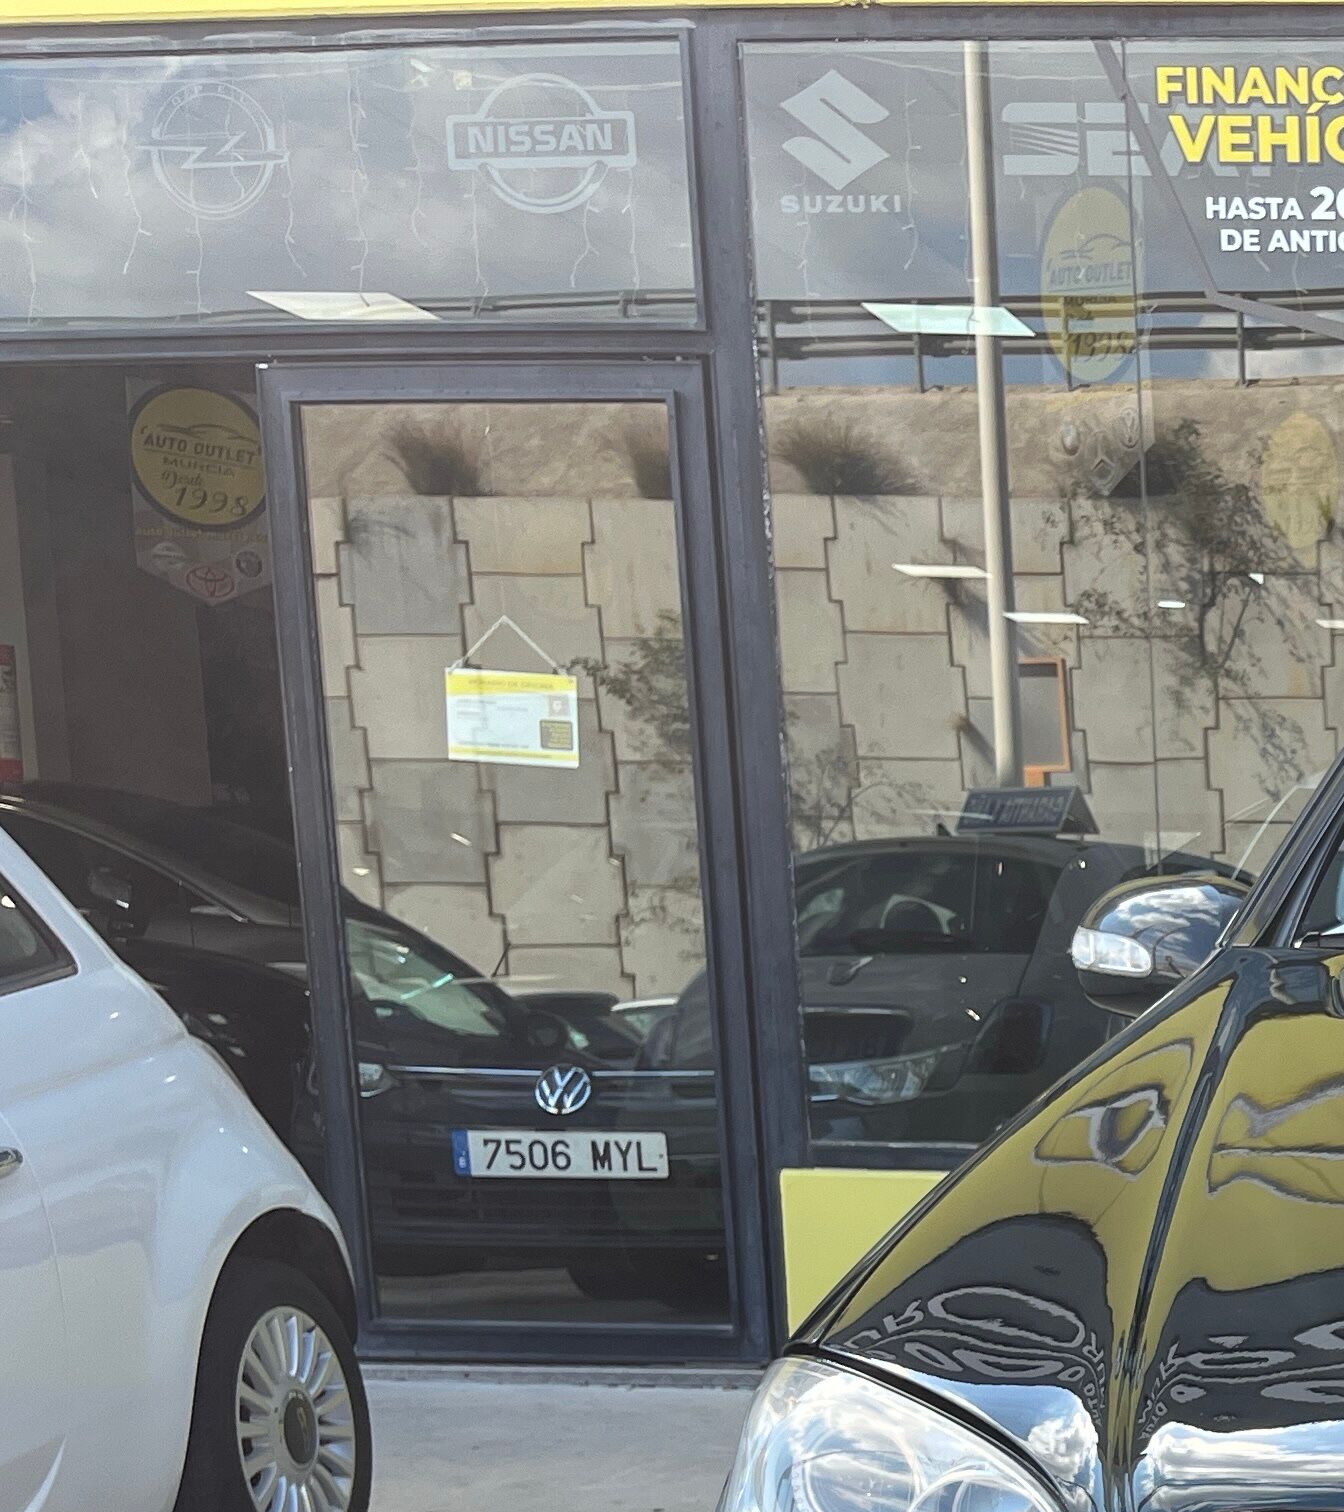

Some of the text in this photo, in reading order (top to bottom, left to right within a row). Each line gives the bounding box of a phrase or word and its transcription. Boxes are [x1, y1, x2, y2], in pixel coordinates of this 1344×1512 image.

[466, 123, 613, 153] NISSAN
[779, 194, 902, 214] SUZUKI
[1205, 196, 1304, 221] HASTA
[1219, 229, 1260, 252] DE
[143, 433, 255, 466] AUTO OUTLET
[175, 486, 249, 517] 1998
[482, 1138, 658, 1172] 7506 MYL
